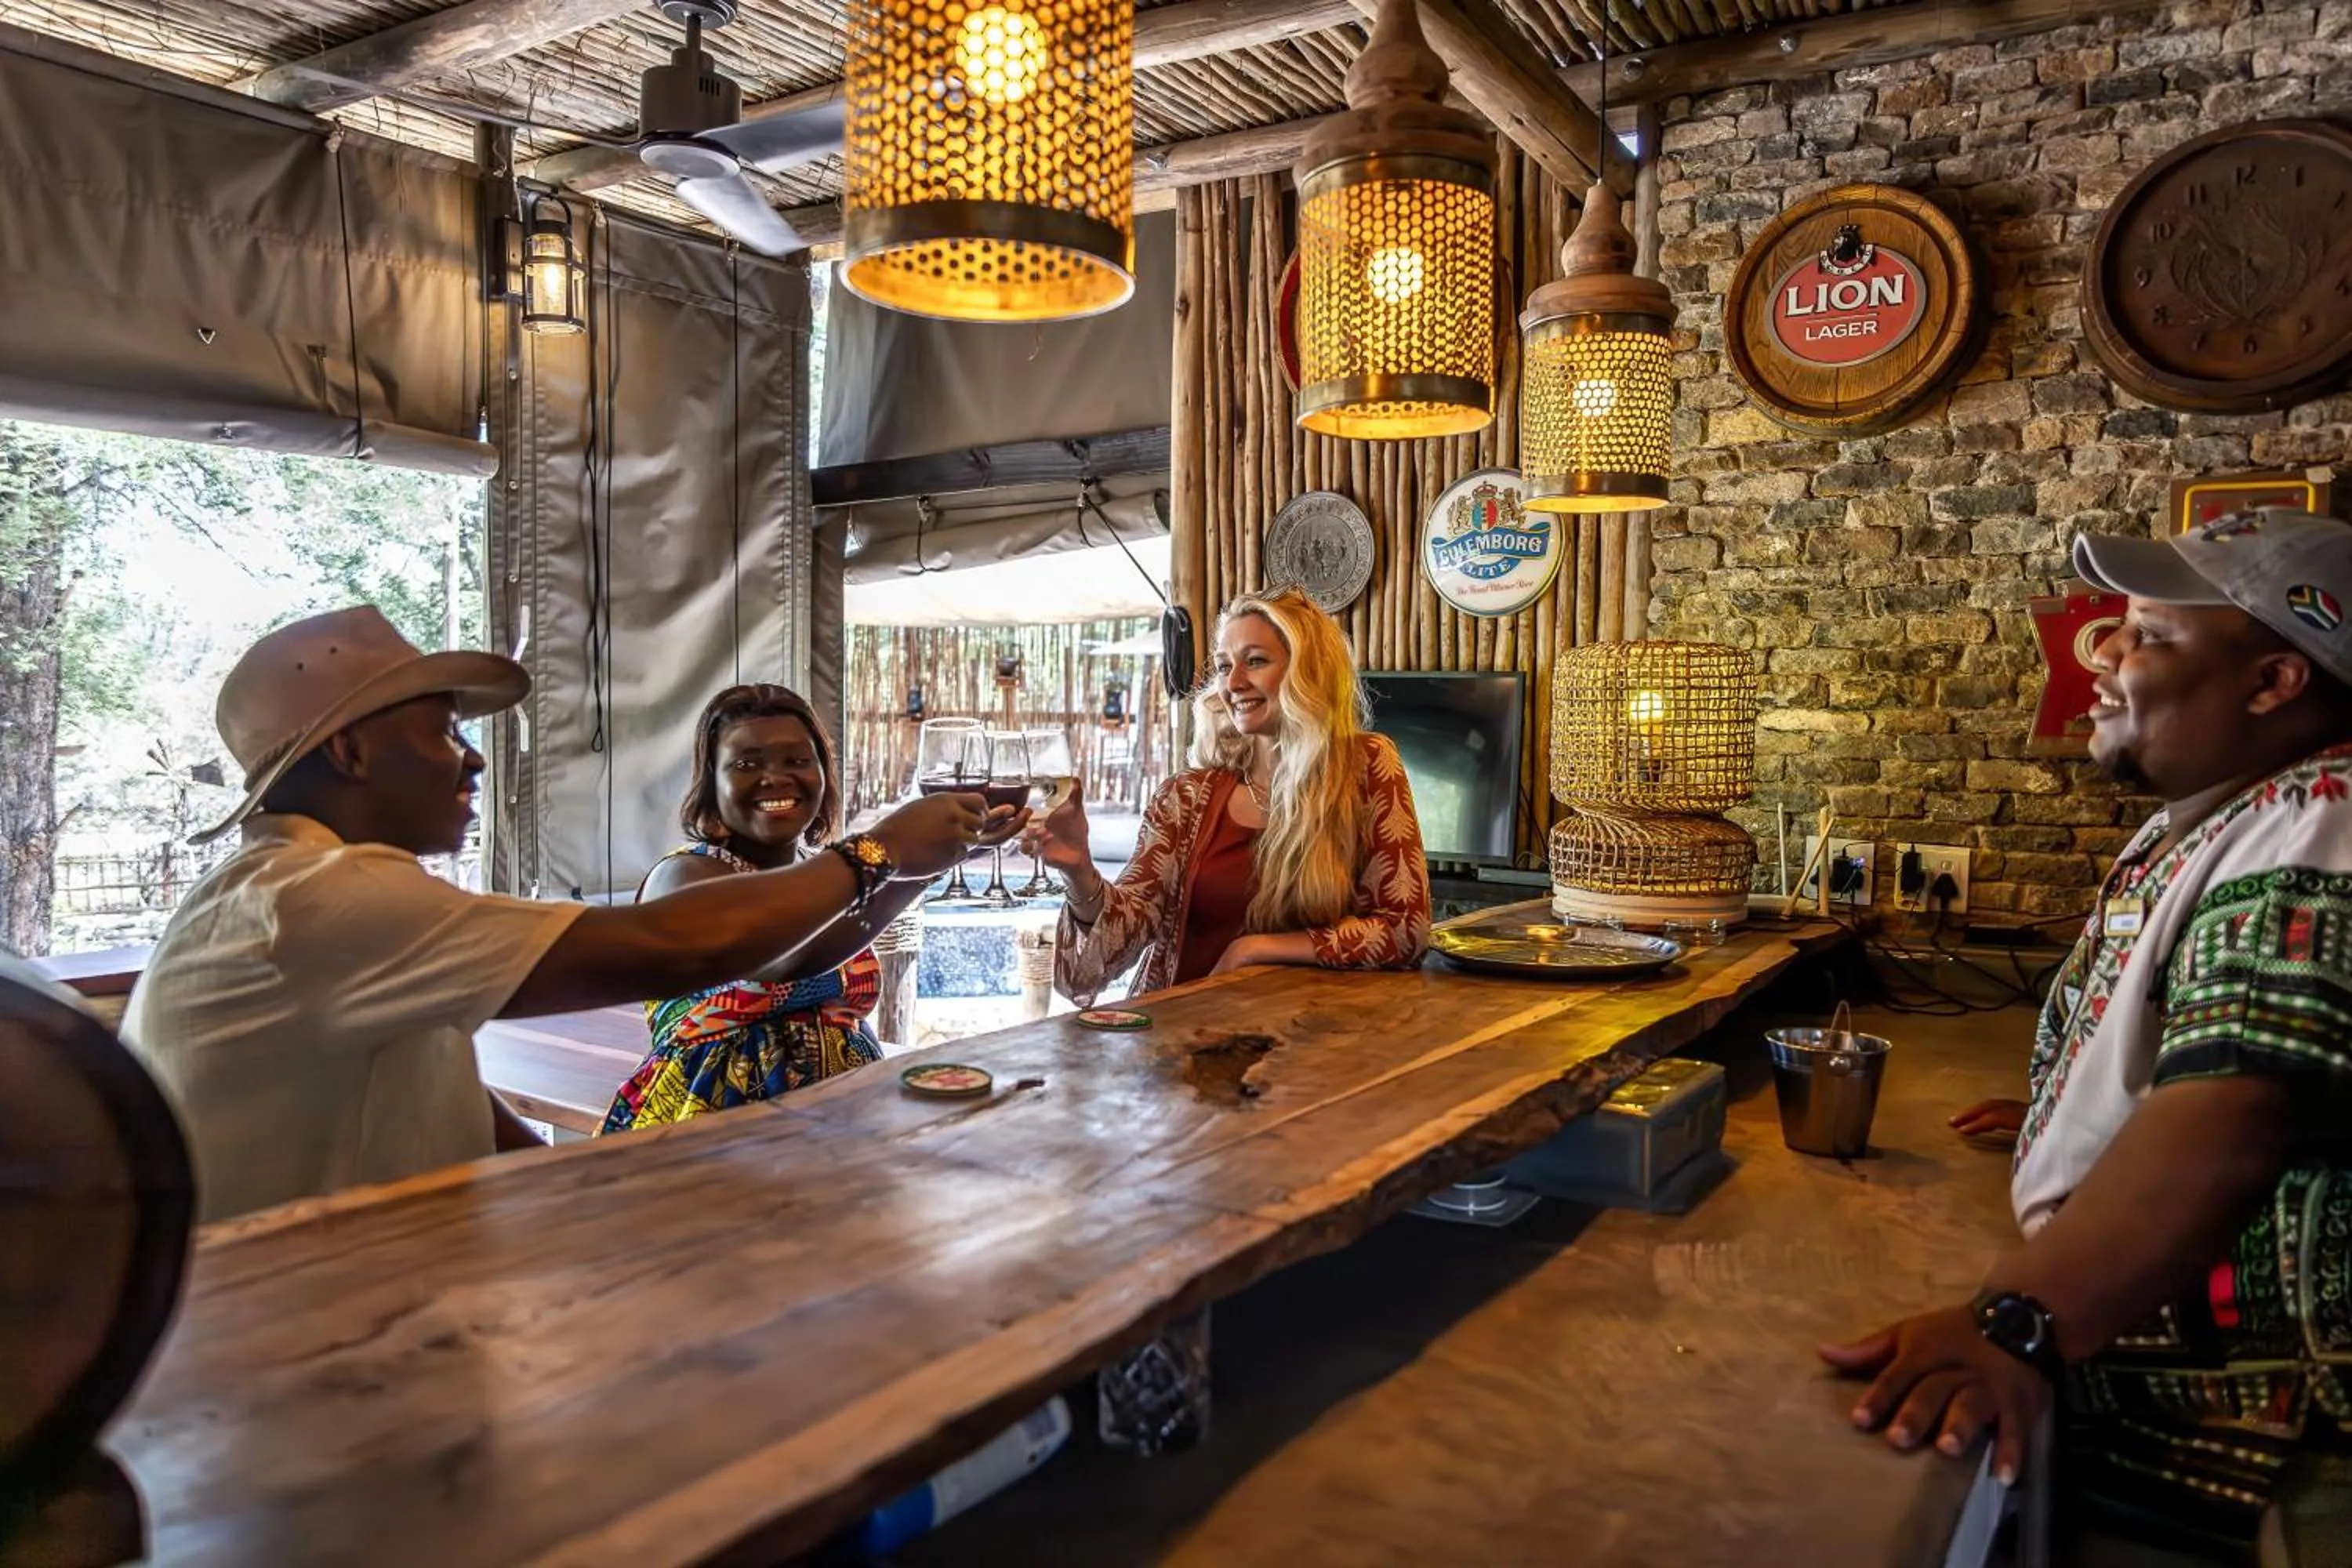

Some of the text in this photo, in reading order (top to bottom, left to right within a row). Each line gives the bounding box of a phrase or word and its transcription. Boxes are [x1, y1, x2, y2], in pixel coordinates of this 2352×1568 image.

[2234, 165, 2257, 187] 12
[2184, 183, 2207, 207] 11
[2148, 222, 2174, 245] 10
[1786, 274, 1904, 316] LION
[1806, 321, 1877, 341] LAGER
[1439, 534, 1542, 567] CULEMBORG
[1466, 560, 1512, 576] LITE
